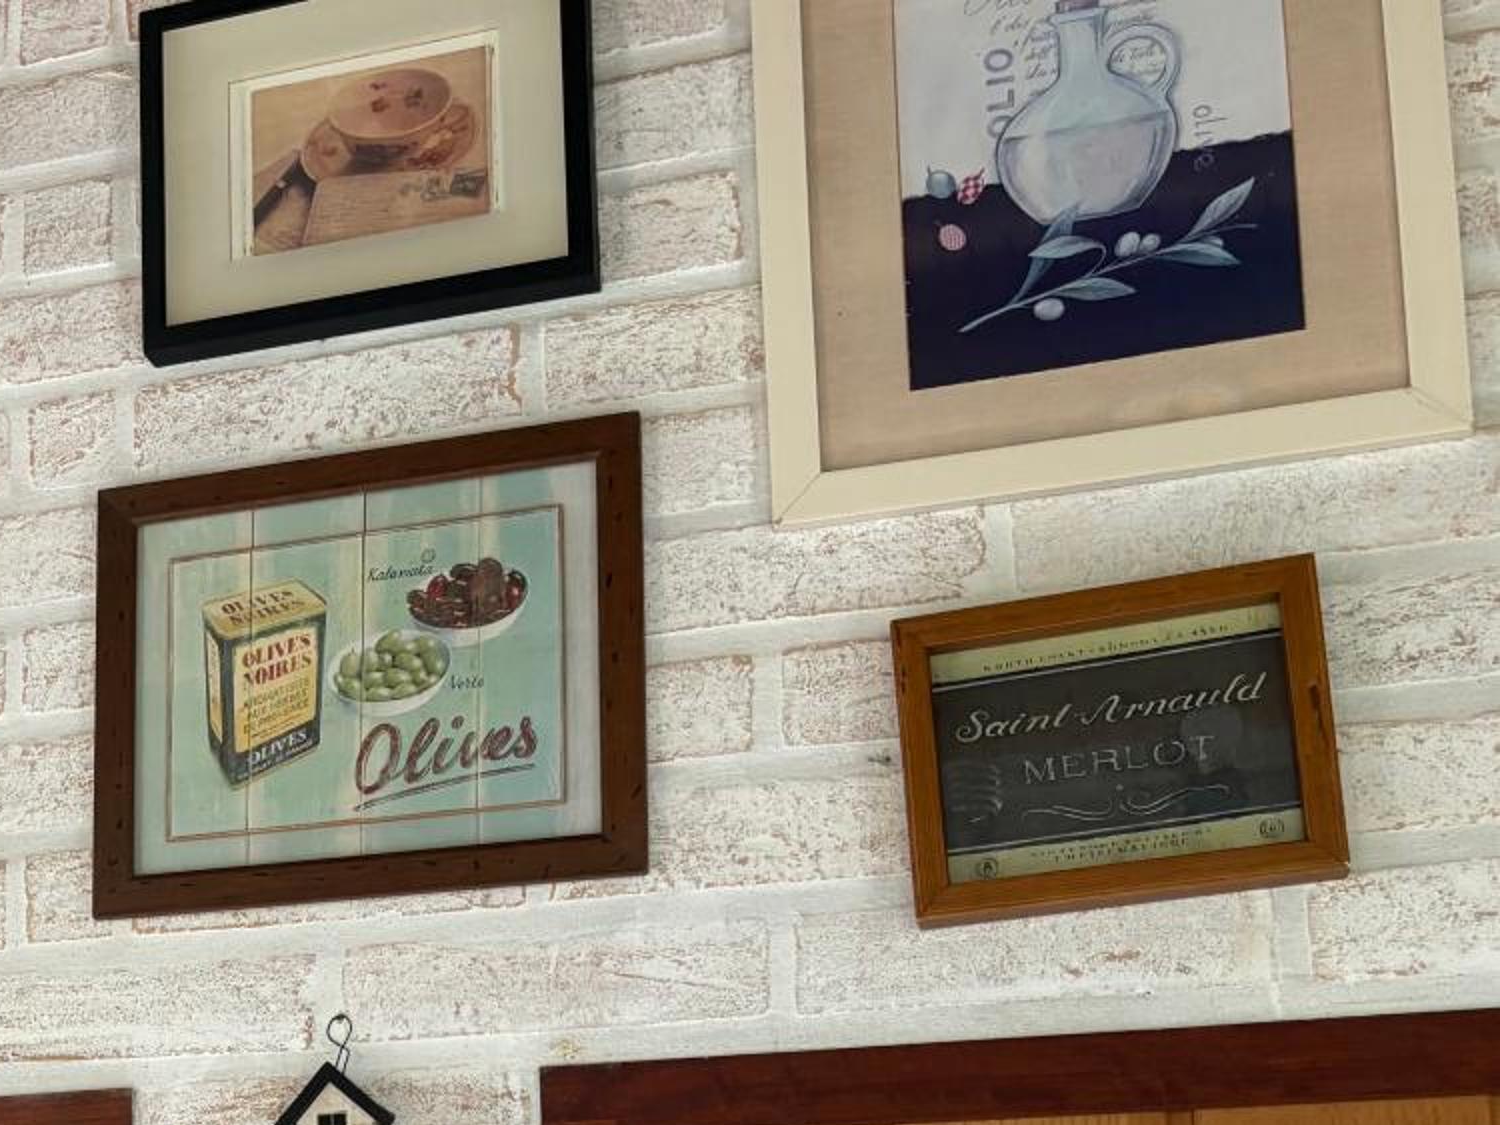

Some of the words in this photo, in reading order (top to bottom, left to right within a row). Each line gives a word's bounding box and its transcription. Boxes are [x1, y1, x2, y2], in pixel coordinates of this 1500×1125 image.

[241, 632, 312, 668] OLIVES
[243, 650, 313, 687] NOIRES
[955, 703, 1073, 744] Saint
[1074, 671, 1268, 725] Arnauld
[354, 715, 538, 796] Olives
[1023, 734, 1216, 785] MERLOT
